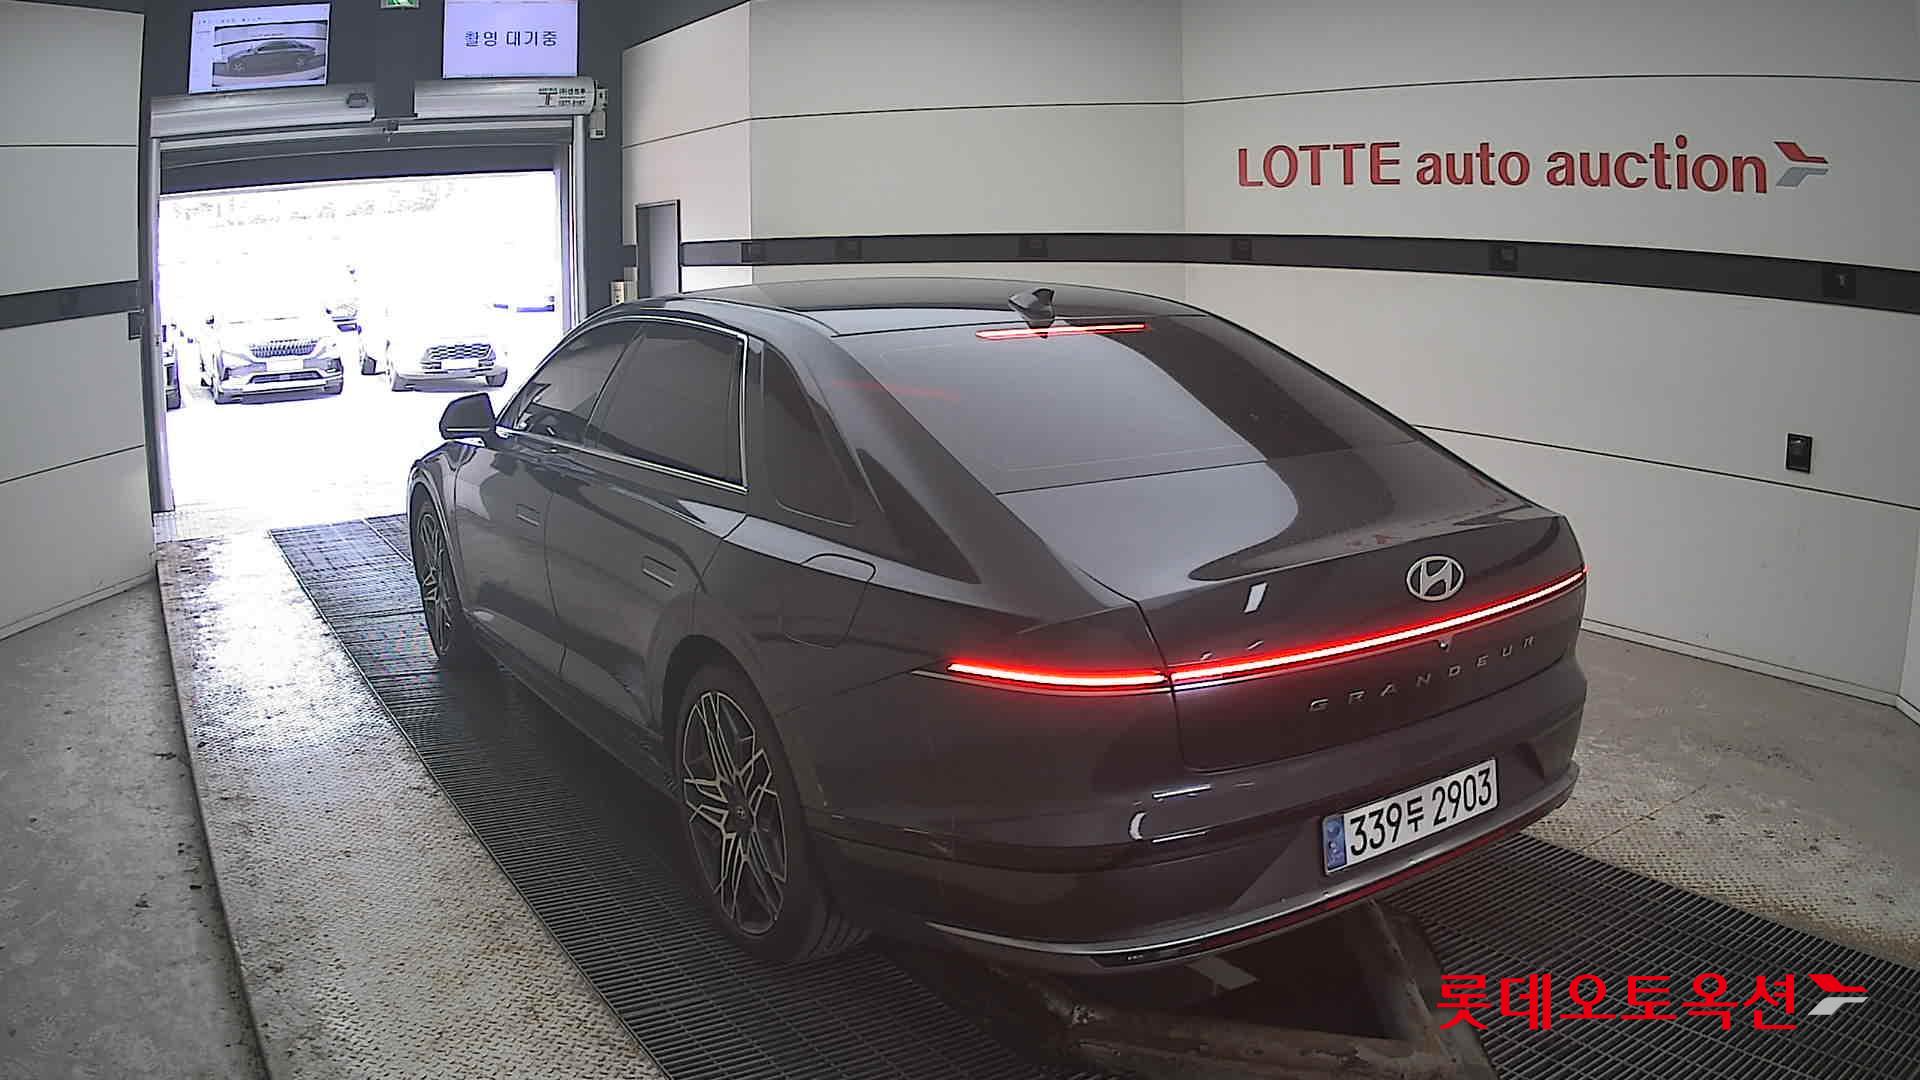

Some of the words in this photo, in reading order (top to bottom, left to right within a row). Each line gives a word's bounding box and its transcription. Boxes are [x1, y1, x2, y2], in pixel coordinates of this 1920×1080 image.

[506, 31, 558, 47] 대기중
[1238, 141, 1400, 188] LOTTE
[1416, 142, 1531, 186] auto
[1546, 134, 1768, 193] auction
[1308, 635, 1535, 711] GRANDEUR
[1350, 796, 1425, 856] 339두
[1431, 767, 1493, 826] 2903
